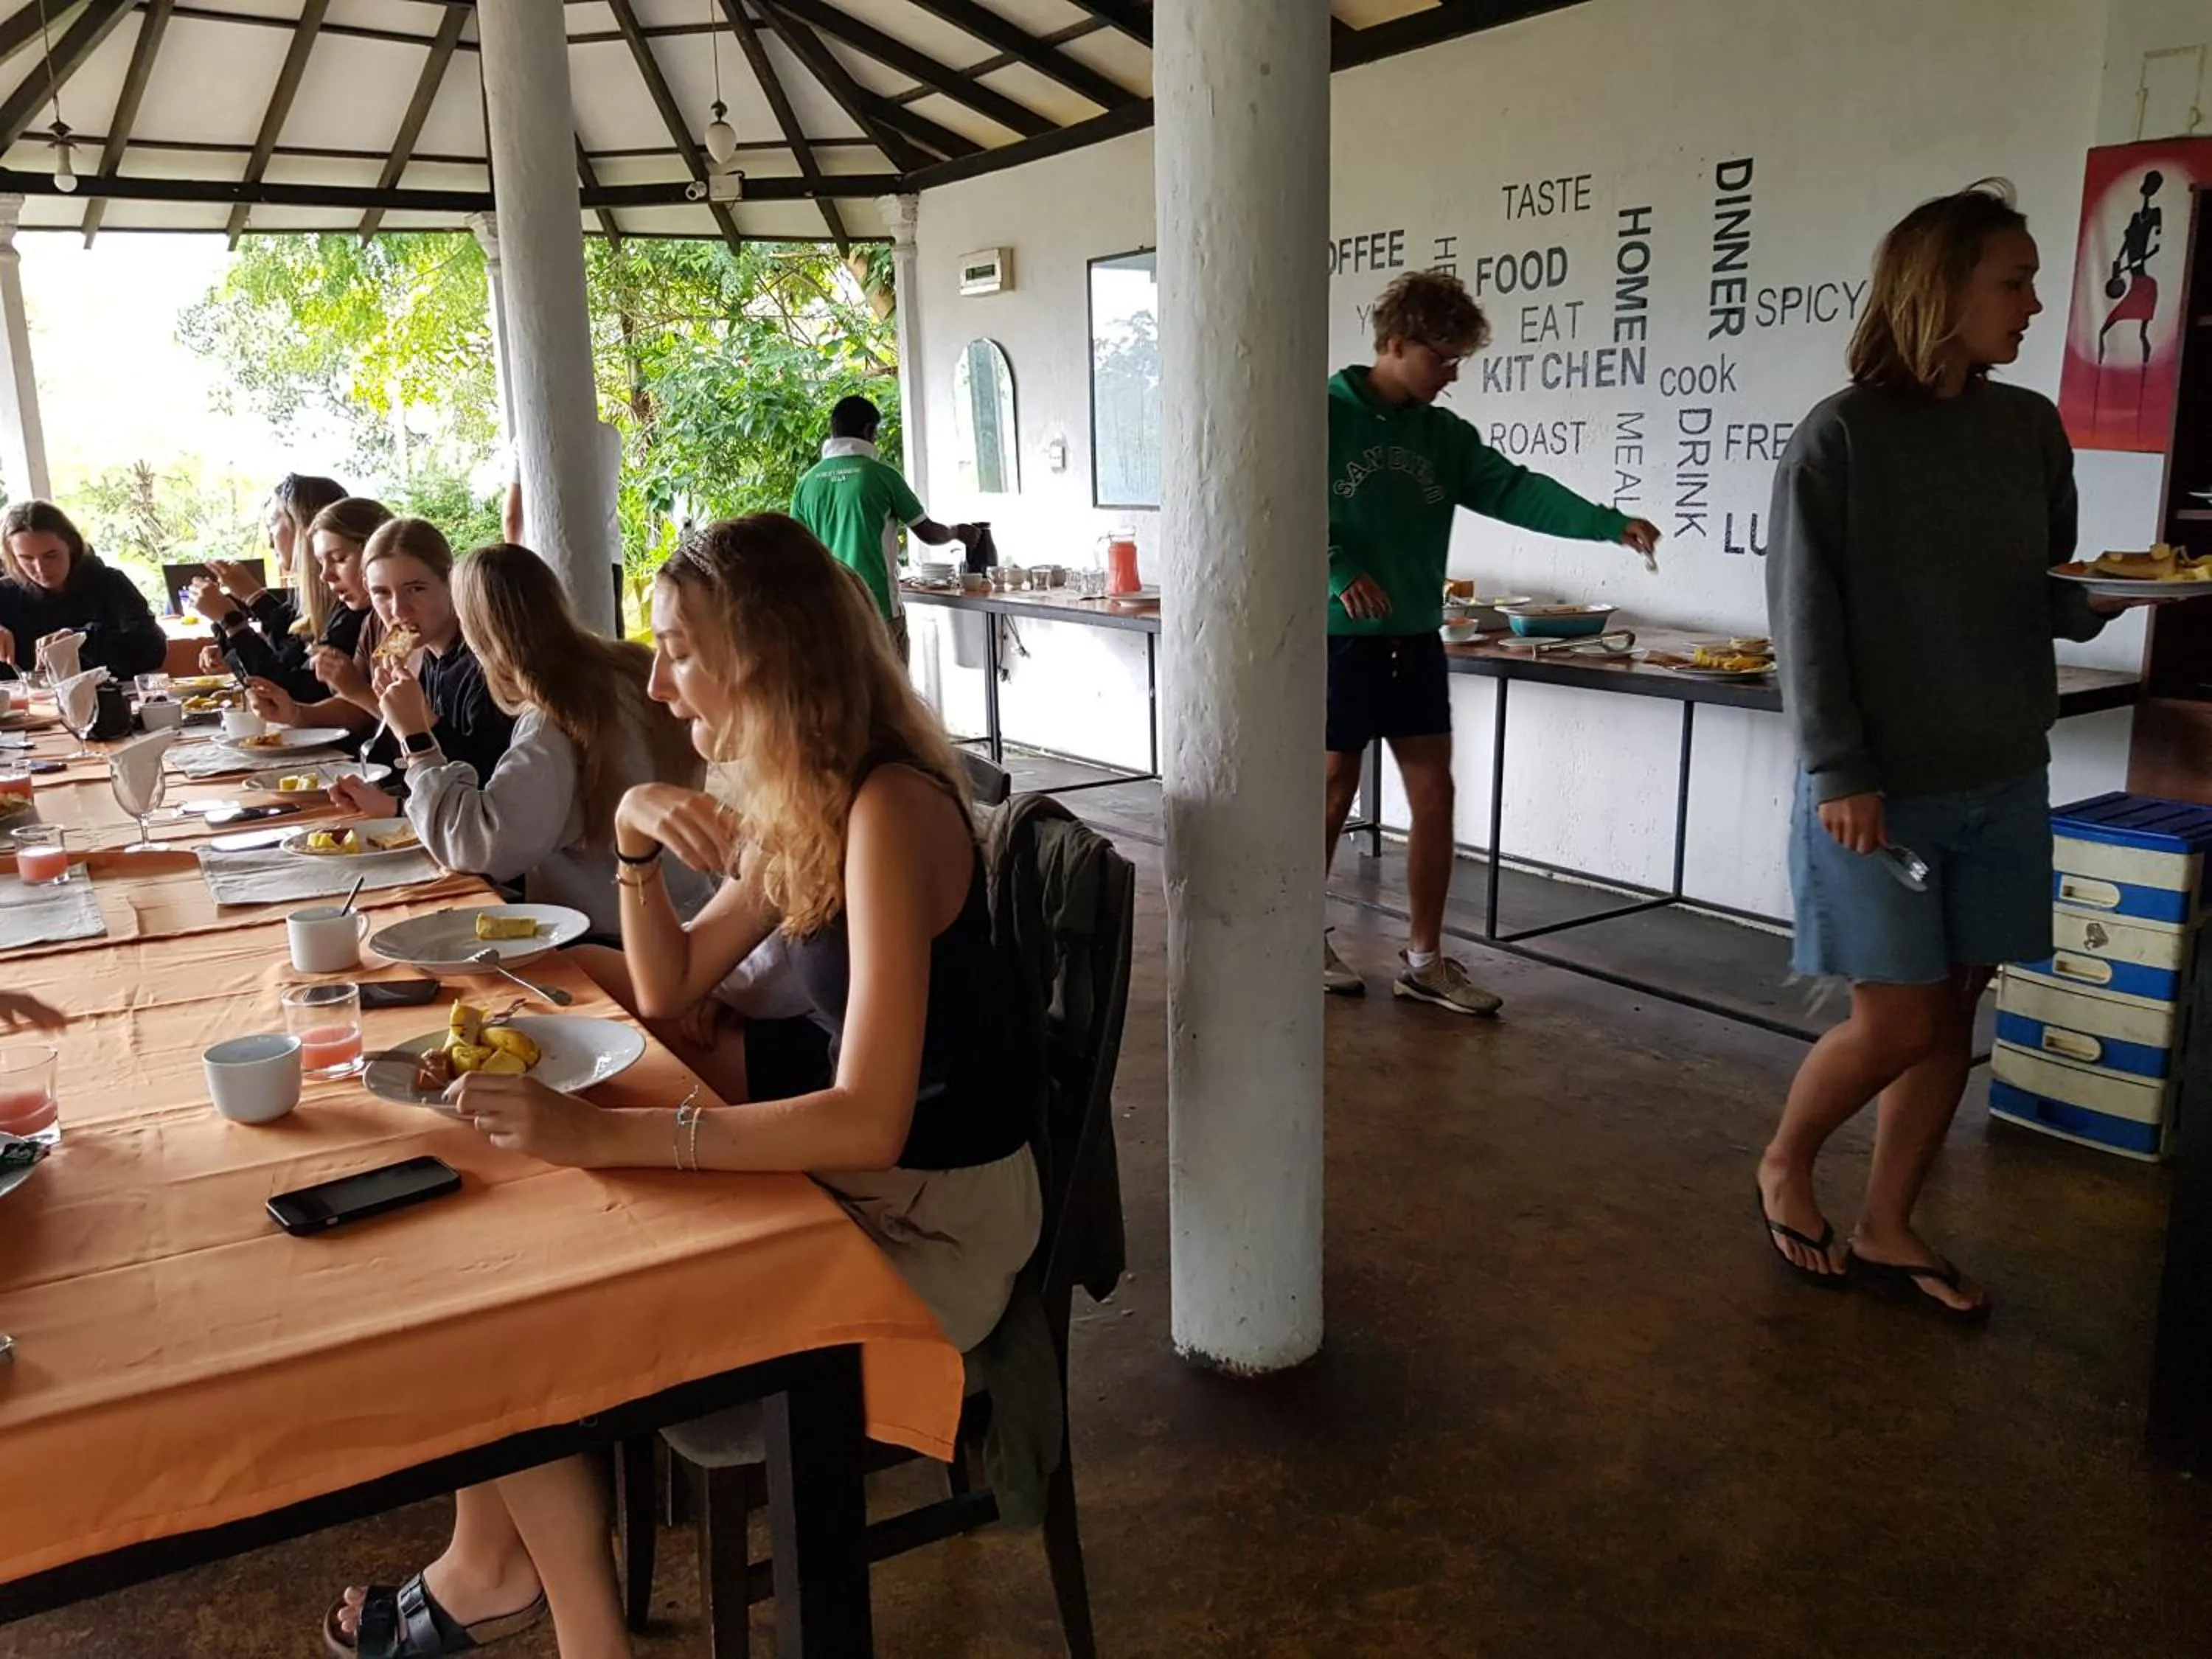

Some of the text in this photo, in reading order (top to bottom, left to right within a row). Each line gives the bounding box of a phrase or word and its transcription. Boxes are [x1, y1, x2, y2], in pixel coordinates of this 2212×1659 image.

[1502, 173, 1592, 220] TASTE
[1476, 246, 1568, 296] FOOD
[1708, 157, 1753, 341] DINNER
[1614, 206, 1652, 343] HOME
[1521, 300, 1585, 344] EAT
[1756, 279, 1868, 327] SPICY
[1482, 346, 1646, 394] KITCHEN
[1490, 421, 1587, 456] ROAST
[1613, 411, 1645, 509] MEAL
[1674, 408, 1712, 538] DRINK
